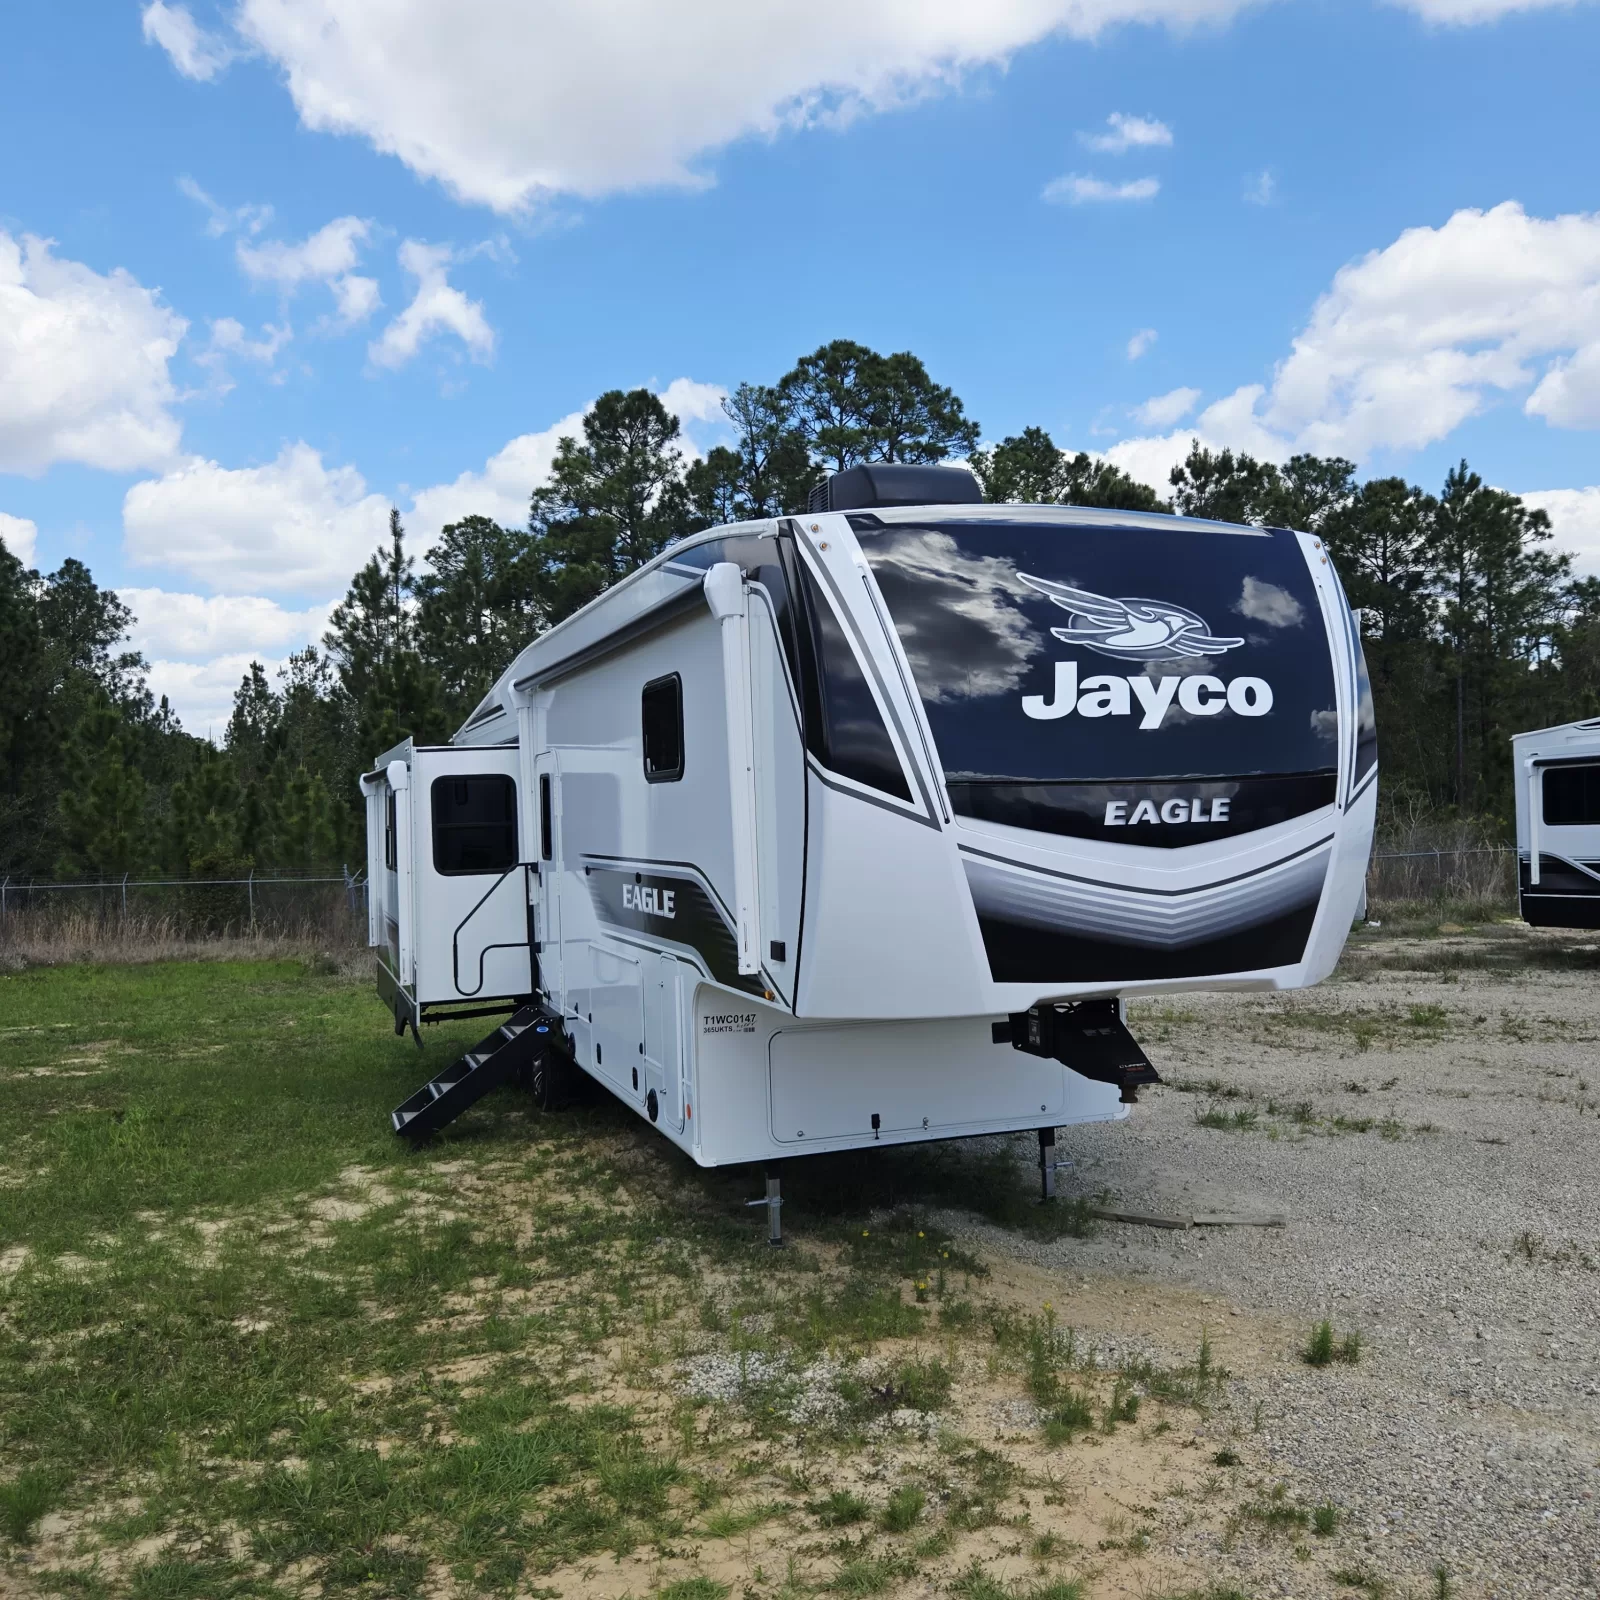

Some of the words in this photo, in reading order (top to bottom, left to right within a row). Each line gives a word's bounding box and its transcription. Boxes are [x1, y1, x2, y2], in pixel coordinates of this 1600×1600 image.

[1021, 661, 1274, 730] Jayco
[1104, 797, 1231, 826] EAGLE
[622, 883, 676, 919] EAGLE
[703, 1014, 756, 1025] T1WC0147
[703, 1026, 733, 1034] 365UKTS
